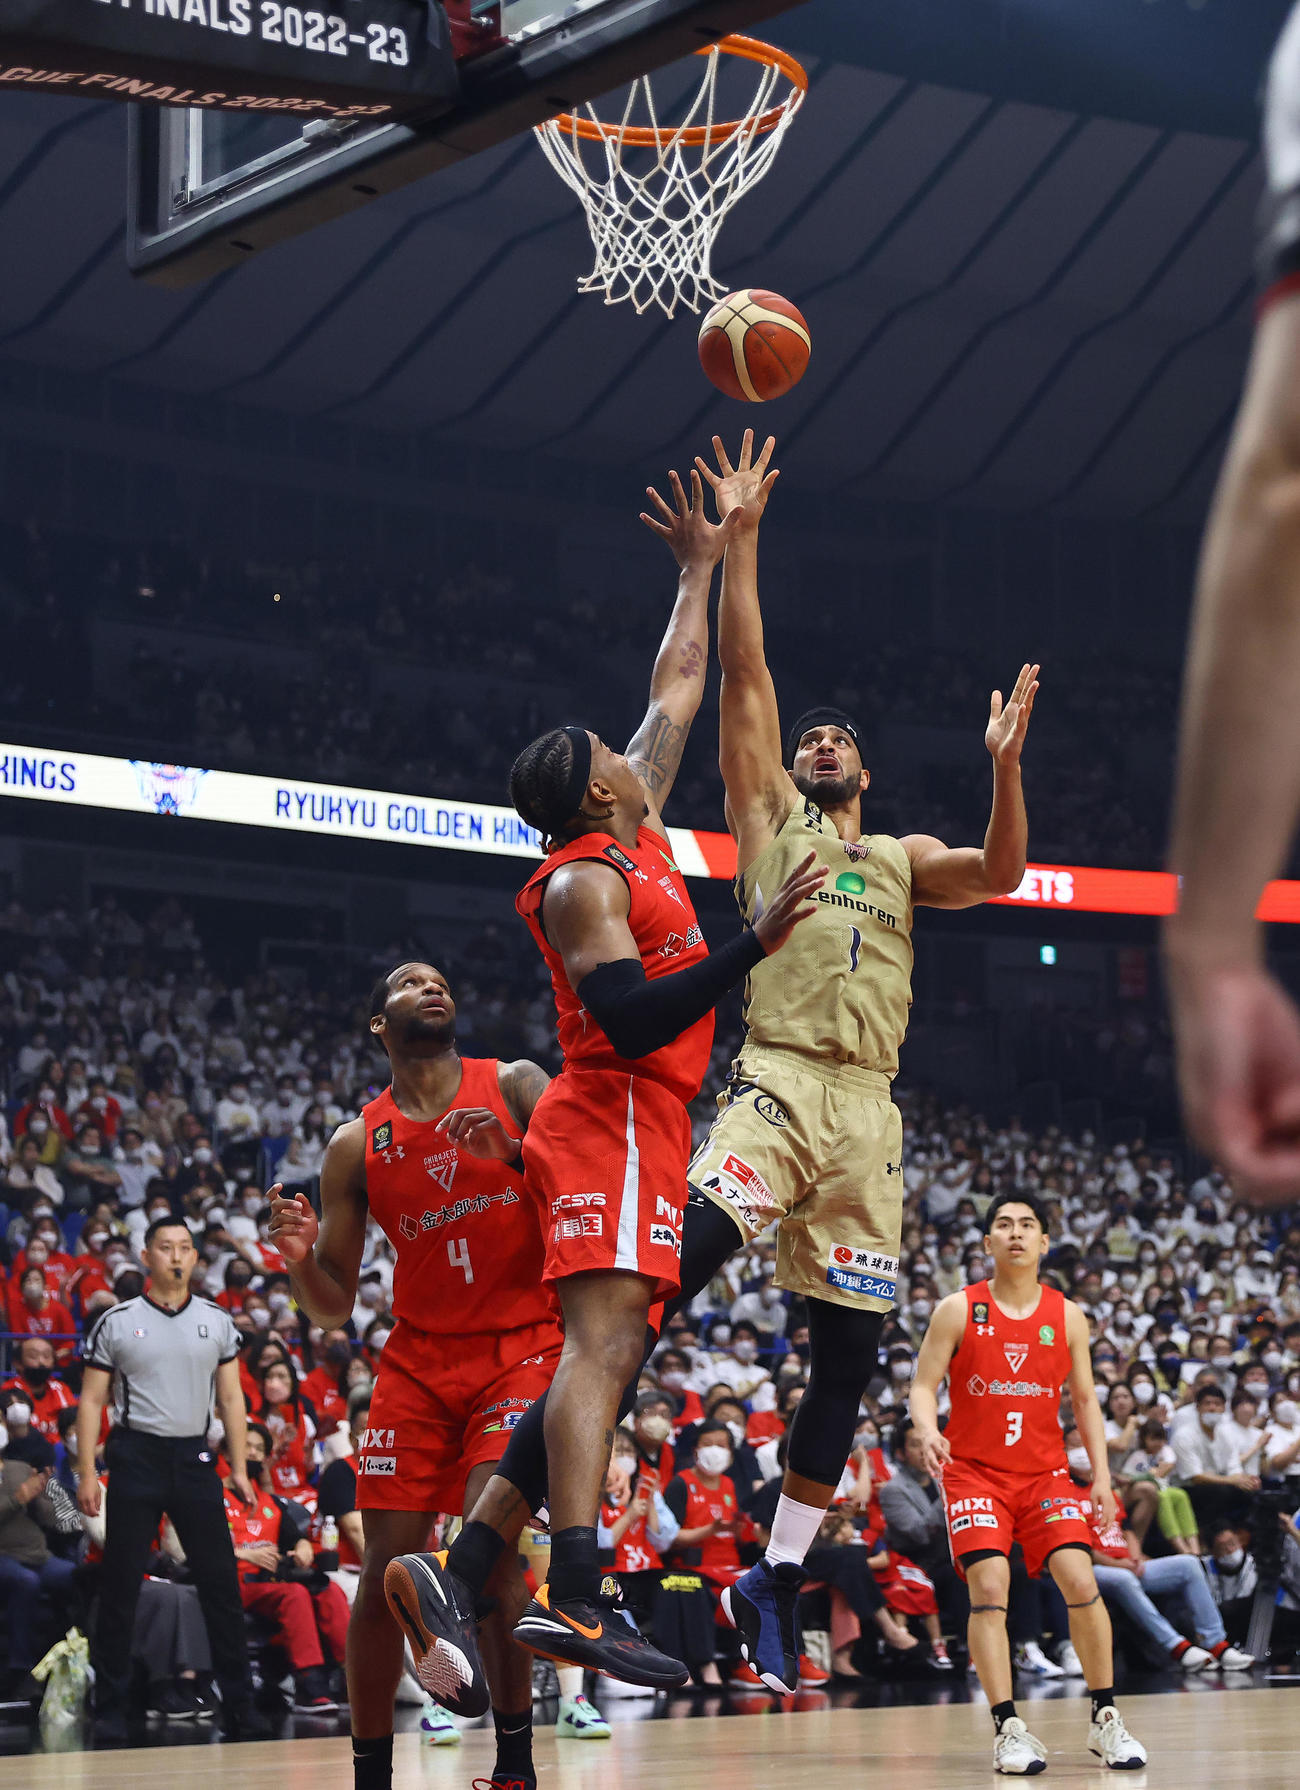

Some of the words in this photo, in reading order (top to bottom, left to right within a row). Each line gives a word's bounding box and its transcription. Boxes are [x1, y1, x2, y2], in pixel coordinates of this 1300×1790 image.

[260, 1, 409, 66] 2022-23
[78, 73, 227, 104] FINALS
[221, 95, 392, 116] 2022-23
[276, 790, 376, 828] RYUKYU
[387, 804, 482, 841] GOLDEN
[848, 924, 862, 974] 1
[419, 1186, 520, 1231] 金太郎ホーム
[446, 1237, 474, 1285] 4
[1004, 1411, 1024, 1447] 3
[950, 1497, 993, 1517] MIXI
